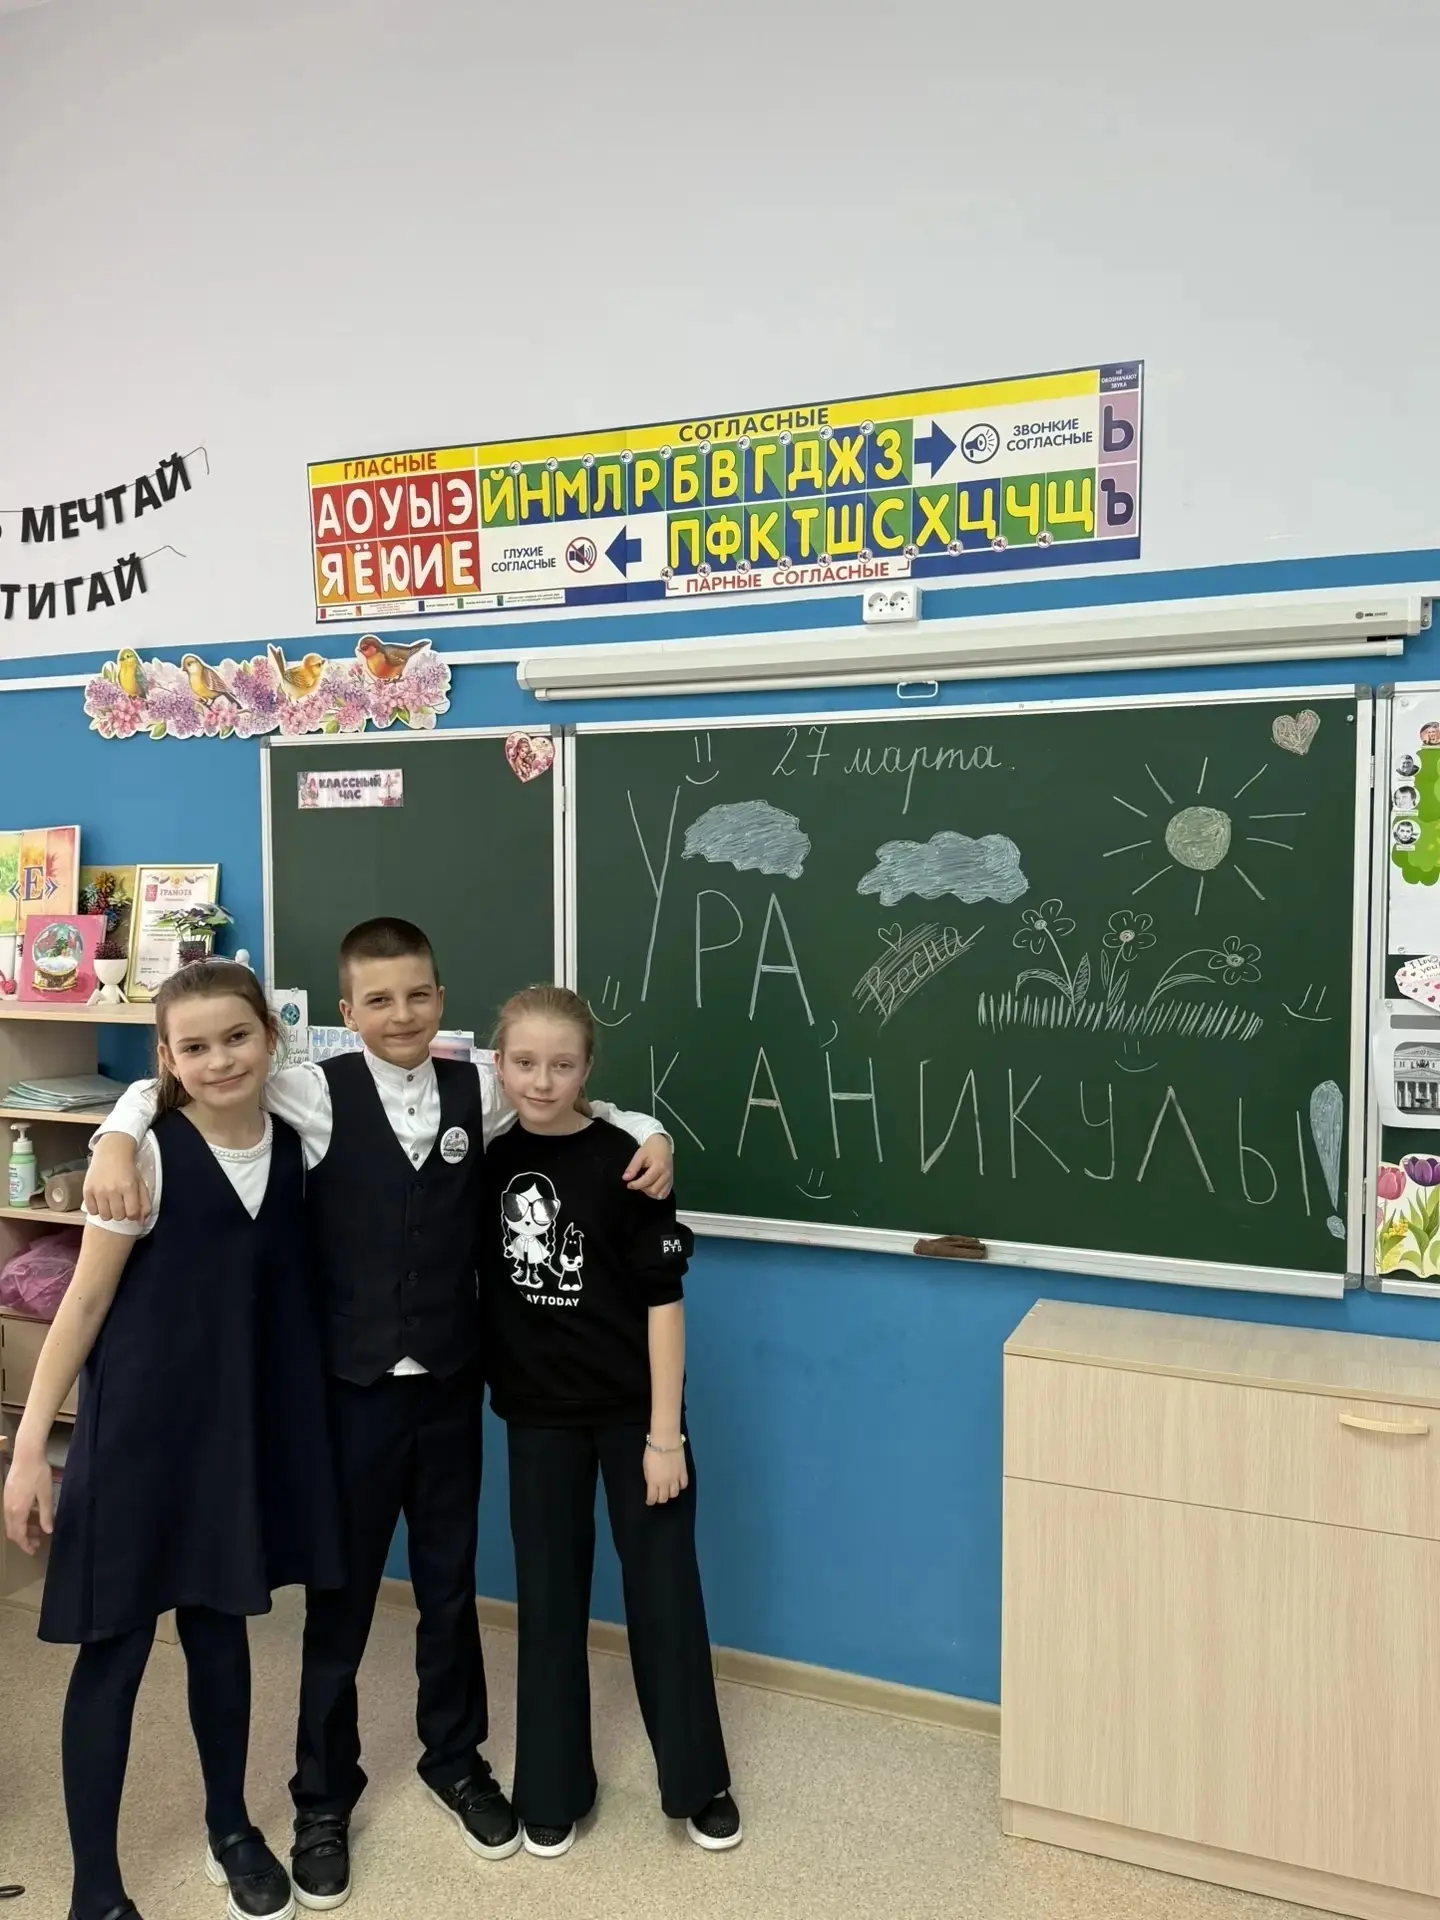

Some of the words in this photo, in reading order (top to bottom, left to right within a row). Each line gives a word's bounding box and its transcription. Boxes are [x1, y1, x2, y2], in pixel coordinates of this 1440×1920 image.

[679, 407, 829, 442] СОГЛАСНЫЕ
[1012, 418, 1080, 436] ЗВОНКИЕ
[1103, 404, 1135, 453] Ь
[1006, 431, 1093, 451] СОГЛАСНЫЕ
[343, 452, 437, 480] ГЛАСНЫЕ
[21, 452, 192, 543] МЕЧТАЙ
[1100, 478, 1135, 527] Ъ
[503, 545, 544, 559] ГЛУХИЕ
[491, 557, 556, 573] СОГЛАСНЫЕ
[0, 552, 148, 620] ТИГАЙ
[686, 574, 762, 593] ПАРНЫЕ
[772, 562, 890, 586] СОГЛАСНЫЕ
[772, 726, 831, 776] 27
[318, 774, 382, 789] КЛАССНЫЙ
[338, 789, 362, 800] ЧАС
[159, 888, 193, 897] ГРАМОТА
[521, 1291, 580, 1307] AYTODAY
